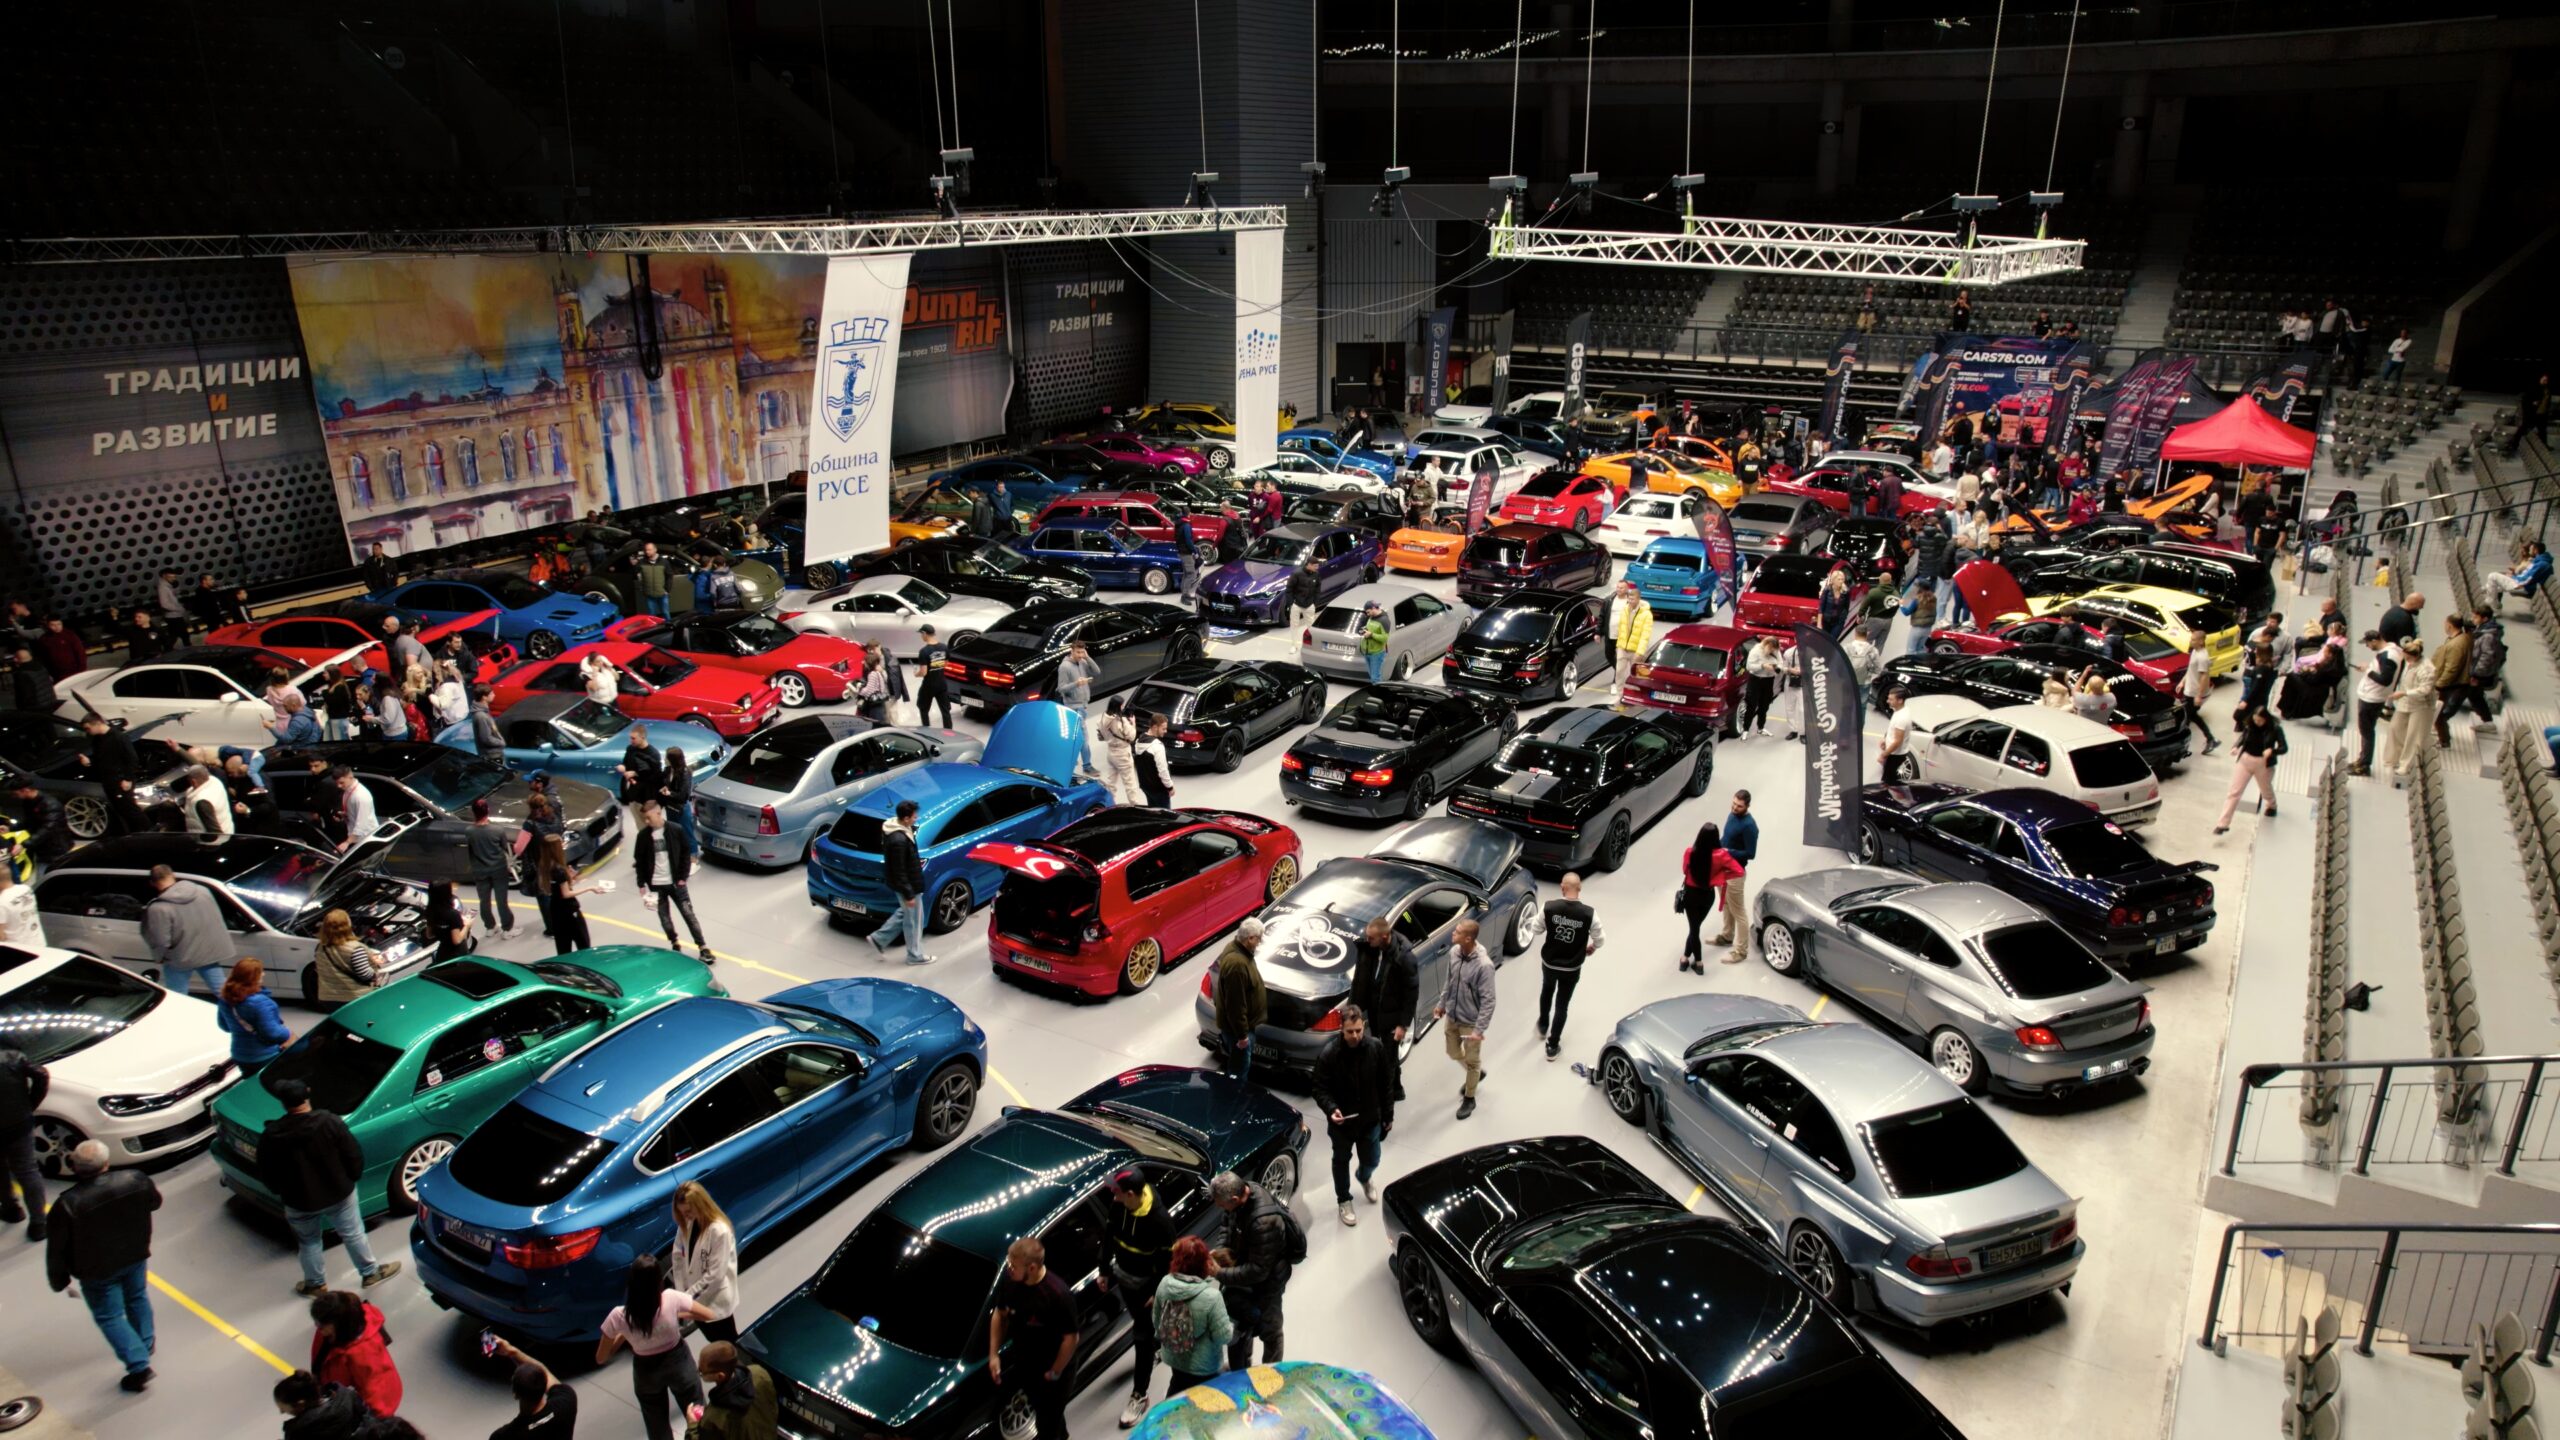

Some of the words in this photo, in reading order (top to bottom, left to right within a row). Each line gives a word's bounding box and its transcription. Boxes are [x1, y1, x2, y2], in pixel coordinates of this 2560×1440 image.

[1056, 279, 1125, 298] ТРАДИЦИИ
[1049, 312, 1113, 333] РАЗВИТИЕ
[1259, 363, 1278, 376] РУСЕ
[1963, 351, 2048, 366] CARS78.COM
[104, 356, 301, 396] ТРАДИЦИИ
[1430, 341, 1441, 407] PEUGEOT
[1566, 342, 1585, 400] Jeep
[209, 393, 229, 412] И
[93, 412, 278, 456] РАЗВИТИЕ
[810, 451, 878, 475] община
[818, 474, 870, 502] РУСЕ
[1554, 925, 1576, 944] 23
